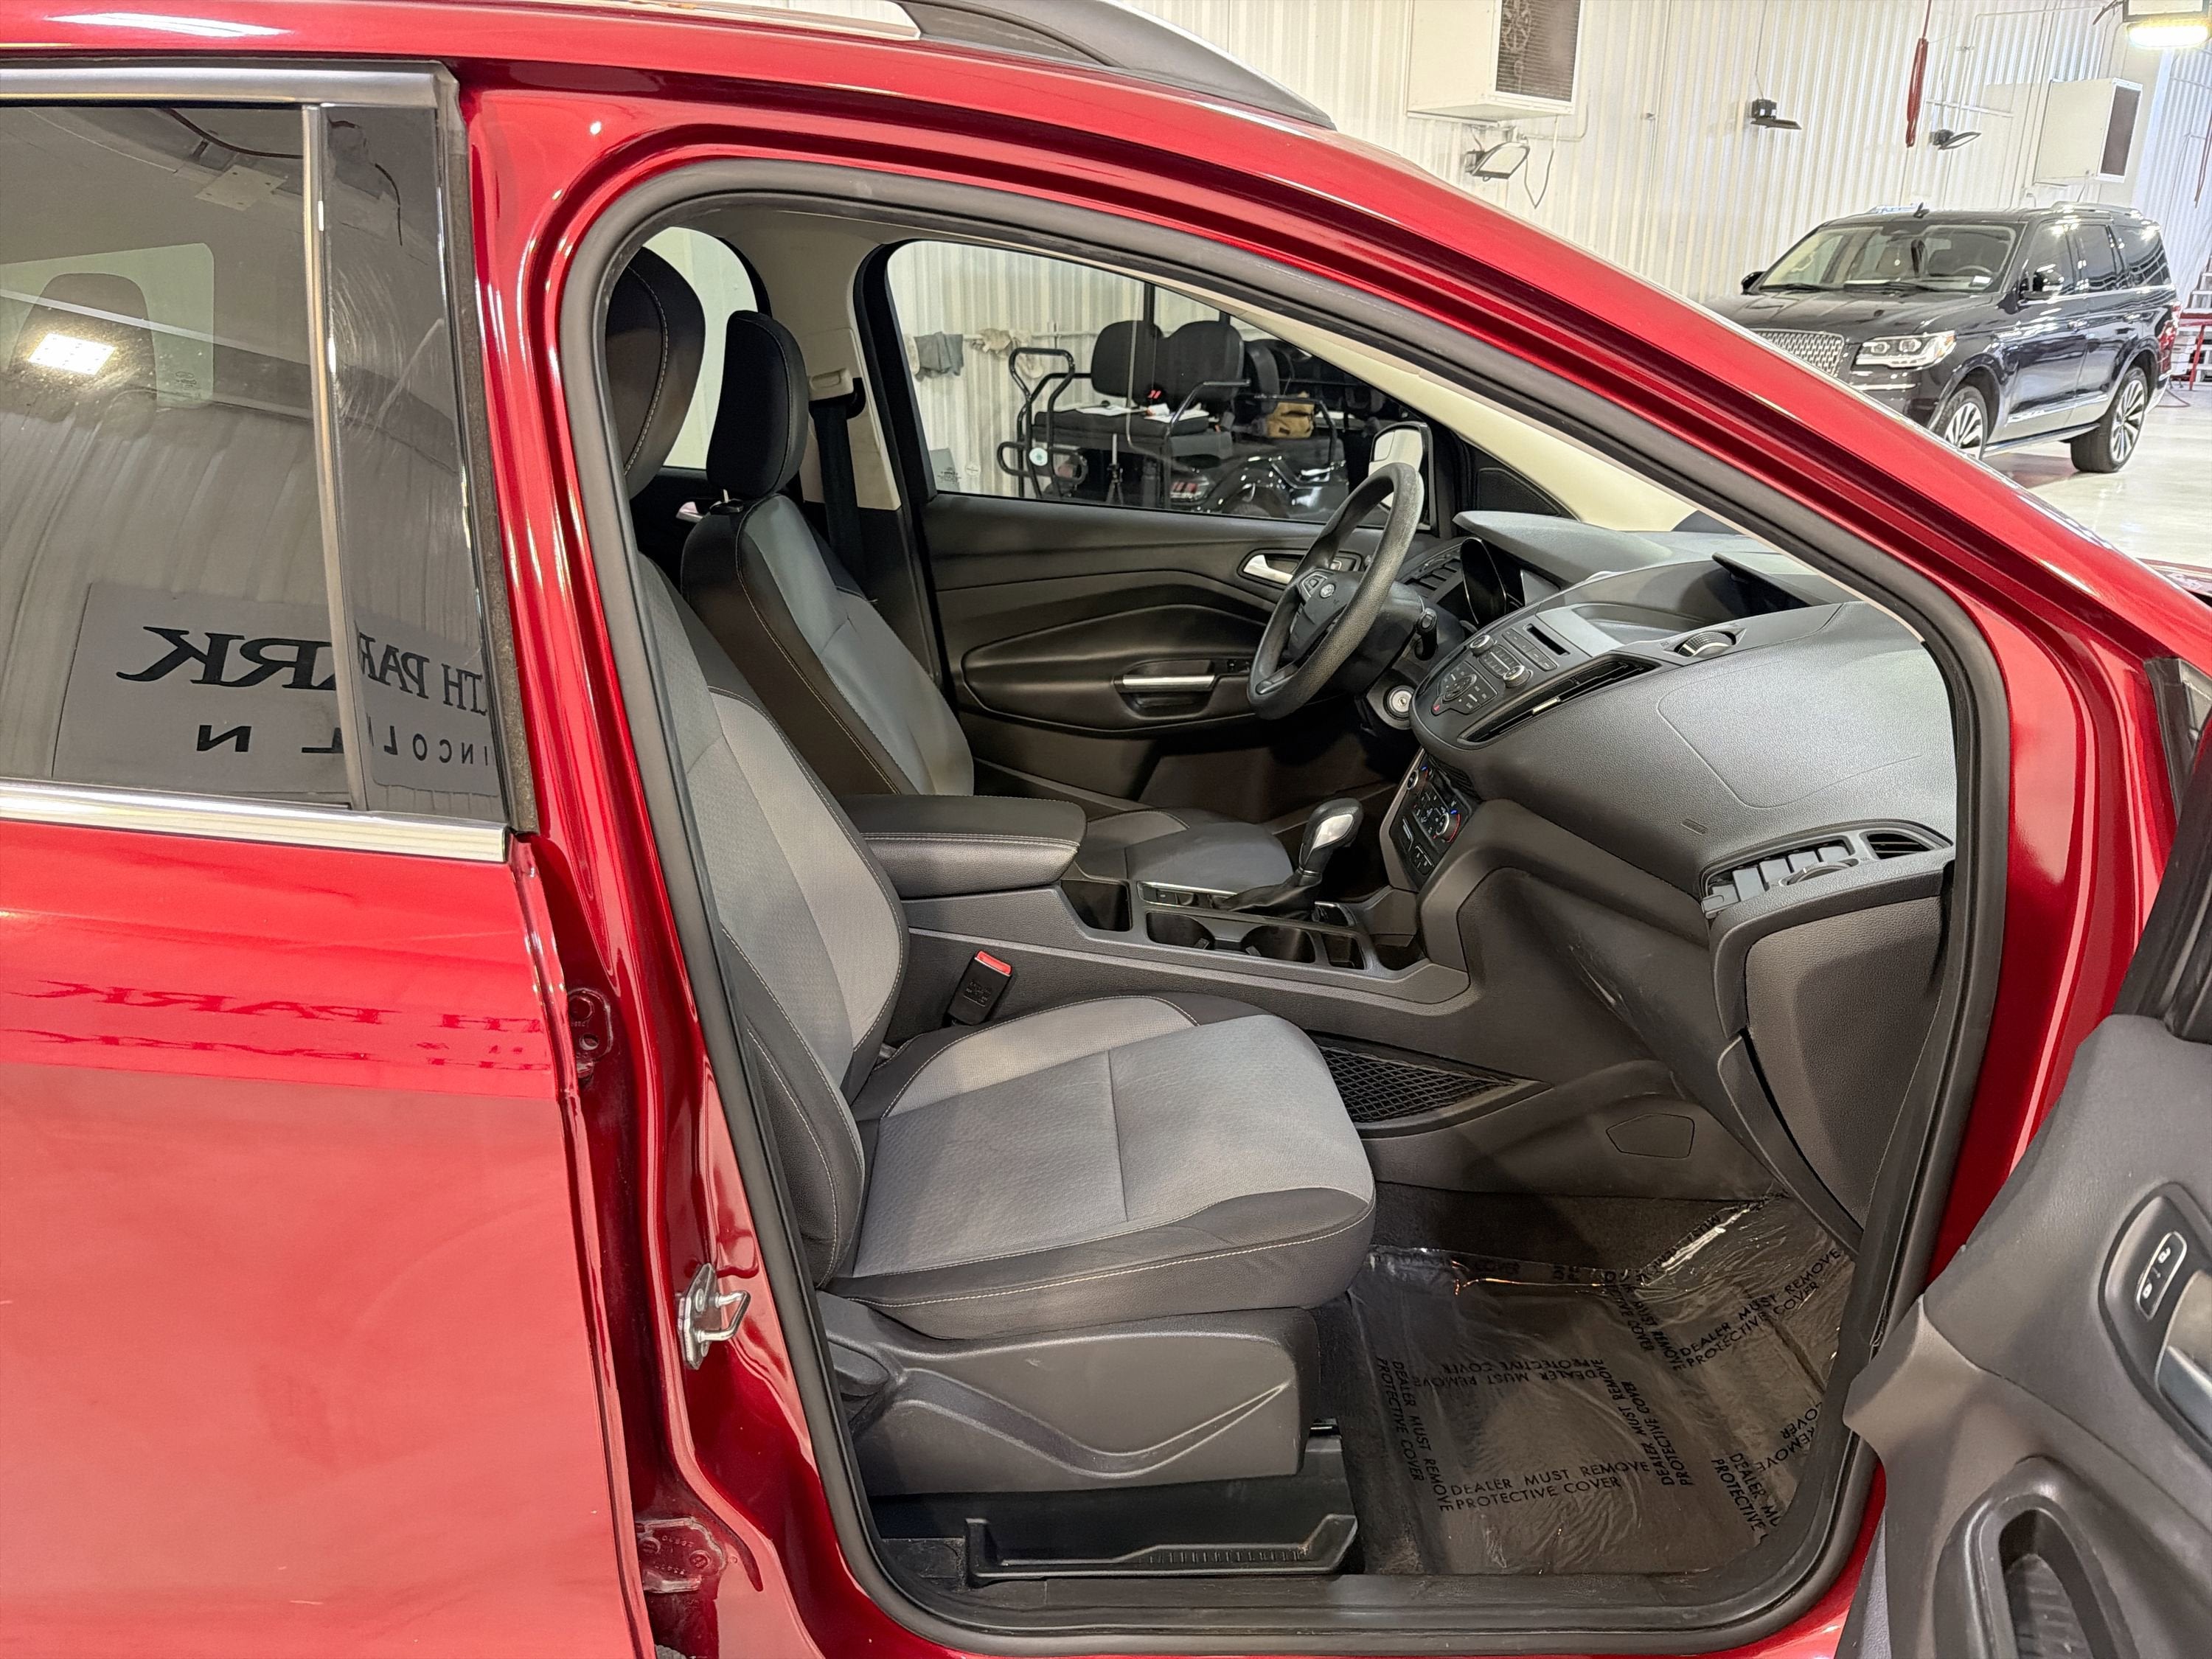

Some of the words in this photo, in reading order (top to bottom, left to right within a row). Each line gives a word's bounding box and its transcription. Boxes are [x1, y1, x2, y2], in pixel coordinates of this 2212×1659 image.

[1680, 1322, 1733, 1357] DEALER
[1738, 1294, 1778, 1321] MUST
[1784, 1248, 1841, 1295] REMOVE
[1687, 1312, 1771, 1368] PROTECTIVE
[1773, 1281, 1819, 1315] COVER
[1590, 1359, 1628, 1401] REMOVE
[1621, 1381, 1650, 1414] COVER
[1375, 1355, 1410, 1434] PROTECTIVE
[1400, 1439, 1425, 1482] COVER
[1392, 1361, 1416, 1407] DEALER
[1409, 1415, 1432, 1452] MUST
[1423, 1458, 1454, 1512] REMOVE
[1618, 1406, 1646, 1436] MUST
[1780, 1401, 1823, 1439] OVER
[1641, 1442, 1675, 1486] DEALER
[1644, 1418, 1694, 1486] PROTECTIVE
[1450, 1478, 1514, 1497] DEALER
[1523, 1469, 1571, 1487] MUST
[1579, 1461, 1651, 1477] REMOVE
[1455, 1484, 1559, 1511] PROTECTIVE
[1563, 1475, 1621, 1494] COVER
[1711, 1458, 1767, 1531] PROTECTIVE
[1729, 1453, 1767, 1499] DEALER
